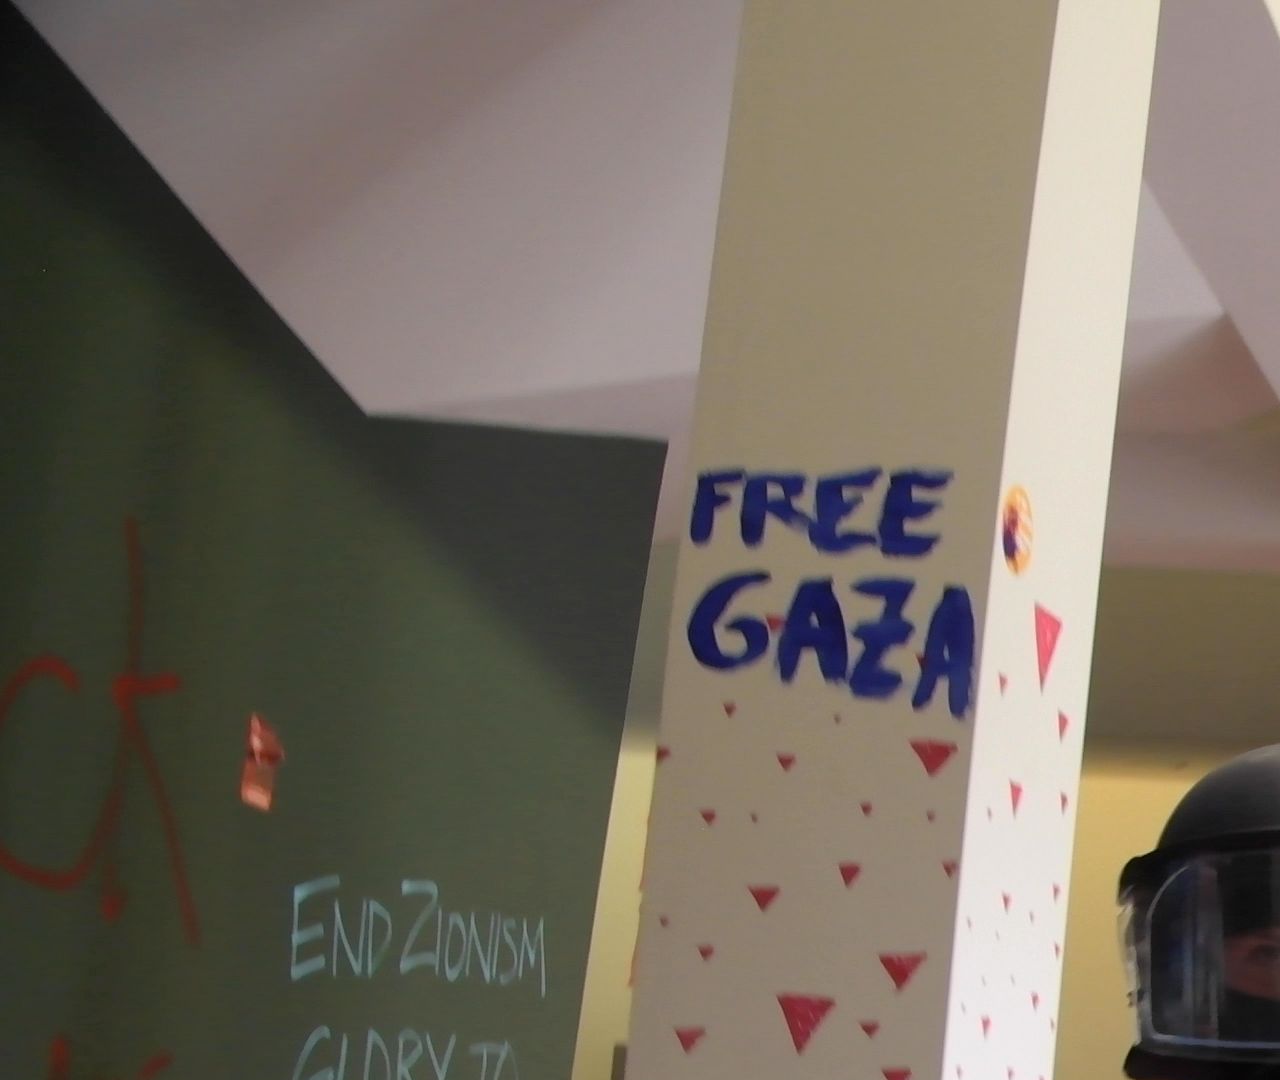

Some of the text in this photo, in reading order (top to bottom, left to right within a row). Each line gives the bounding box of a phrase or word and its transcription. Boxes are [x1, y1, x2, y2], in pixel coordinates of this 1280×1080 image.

[690, 465, 955, 557] FREE
[687, 570, 976, 718] GAZA
[290, 874, 546, 999] END ZIONISM
